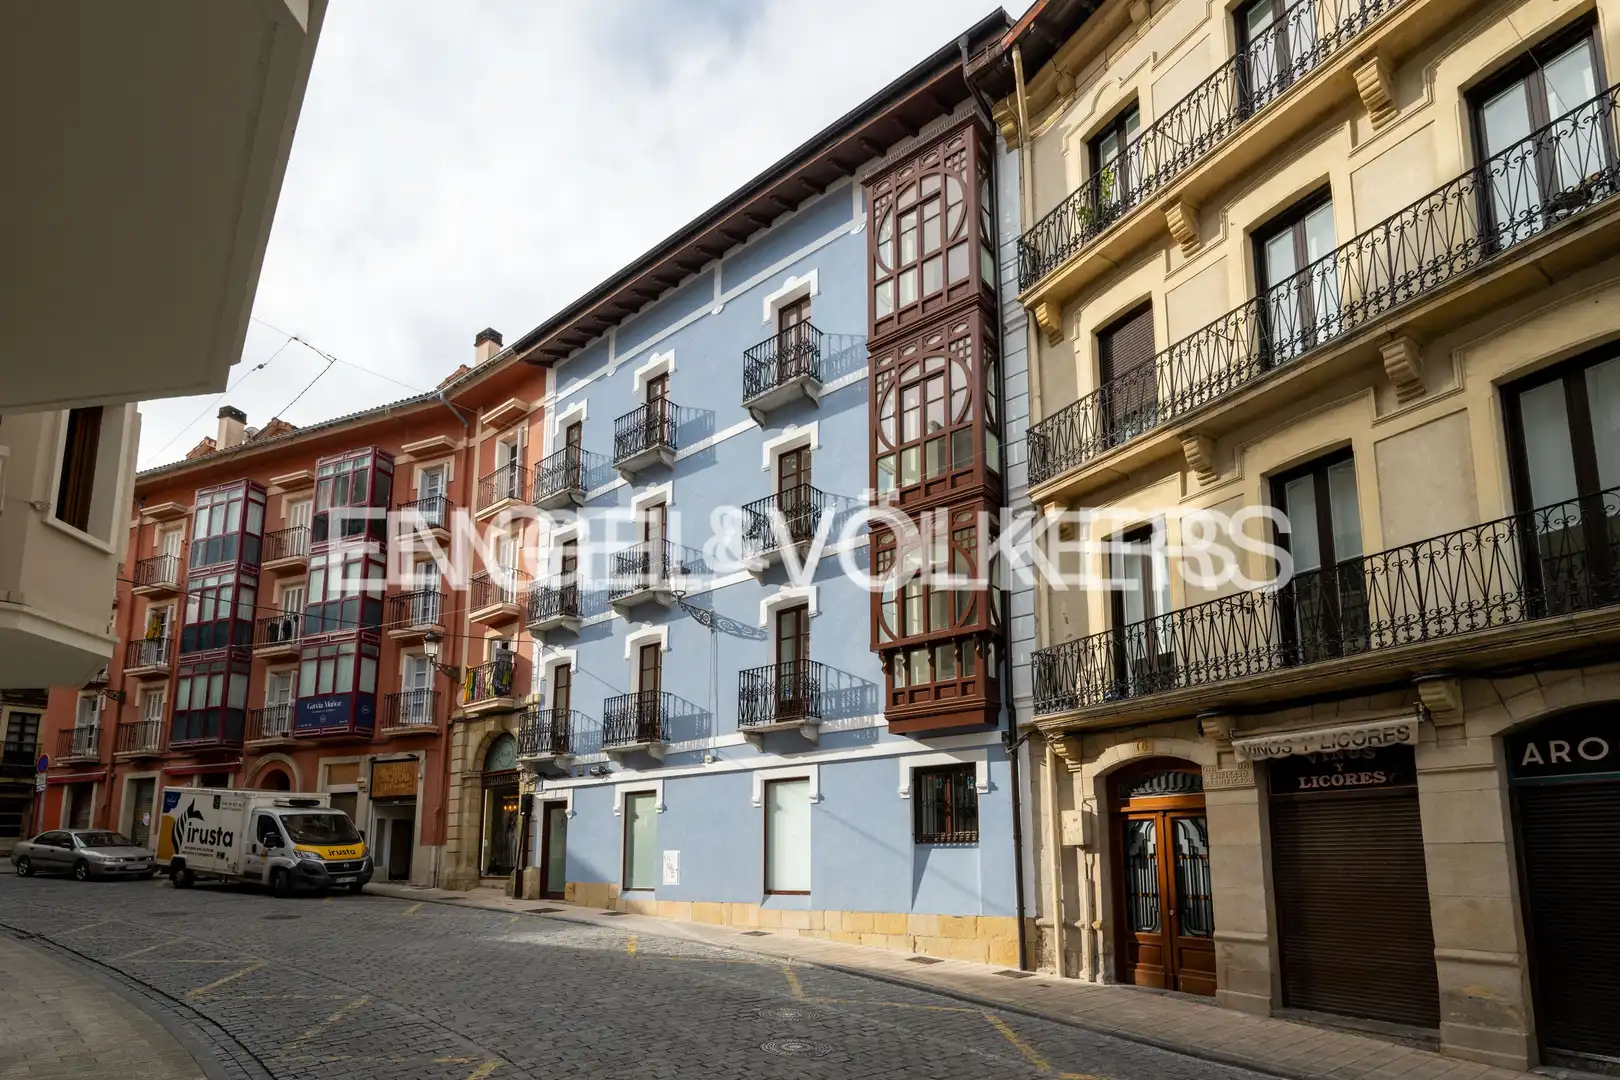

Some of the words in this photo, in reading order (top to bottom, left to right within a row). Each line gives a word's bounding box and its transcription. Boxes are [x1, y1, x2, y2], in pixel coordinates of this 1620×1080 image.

[1240, 739, 1293, 757] VINOS
[1320, 724, 1411, 750] LICORES
[1334, 763, 1344, 772] Y
[1298, 771, 1387, 789] LICORES
[187, 821, 234, 847] irusta
